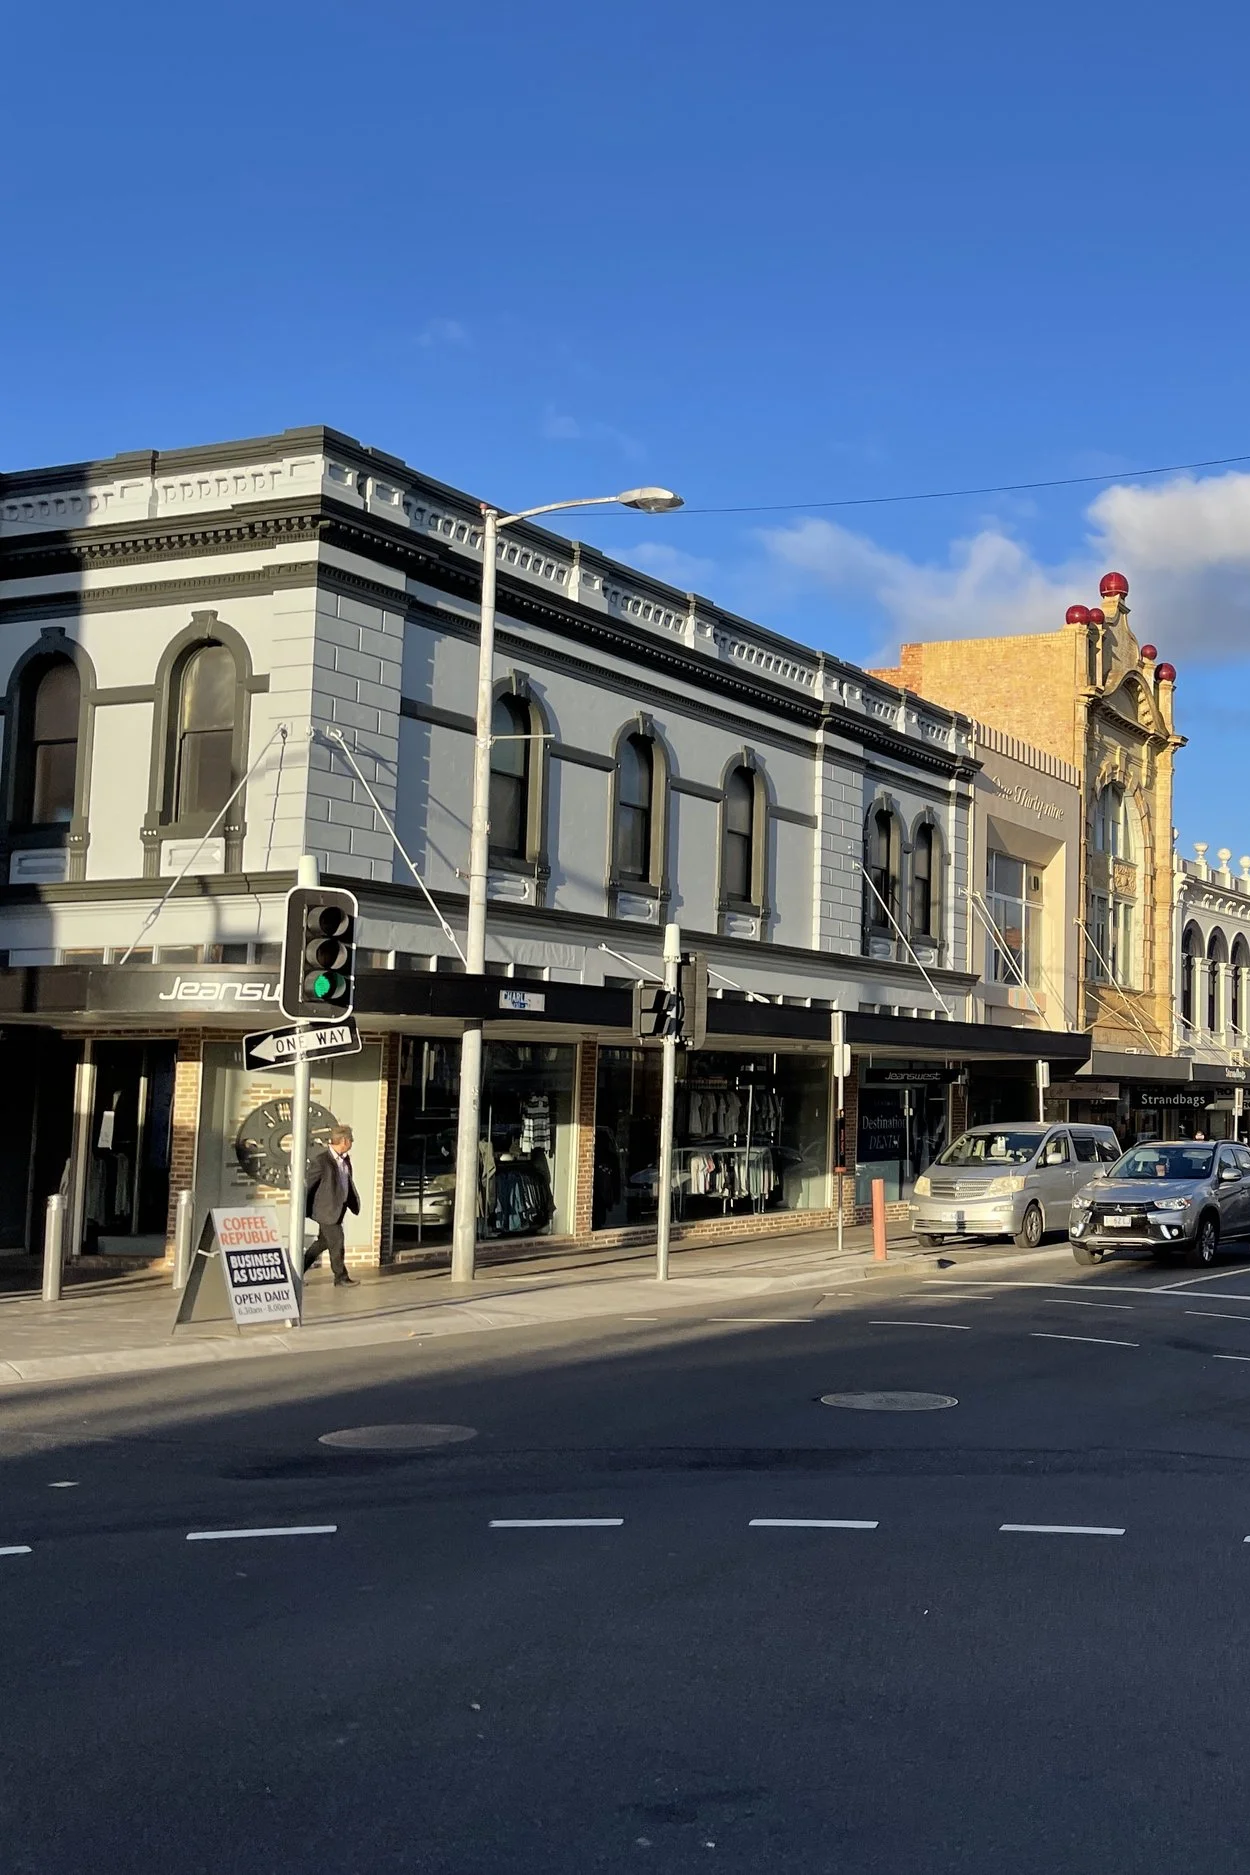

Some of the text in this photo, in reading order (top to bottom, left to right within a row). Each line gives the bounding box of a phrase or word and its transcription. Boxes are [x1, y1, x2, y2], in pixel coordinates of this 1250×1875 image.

[276, 1028, 347, 1054] ONE WAY
[884, 1071, 941, 1081] Jeanswest
[1141, 1093, 1206, 1107] Strandbags
[223, 1216, 268, 1231] COFFEE
[220, 1230, 279, 1245] REPUBLIC
[229, 1252, 281, 1269] BUSINESS
[233, 1266, 285, 1283] AS USUAL
[234, 1289, 291, 1305] OPEN DAILY
